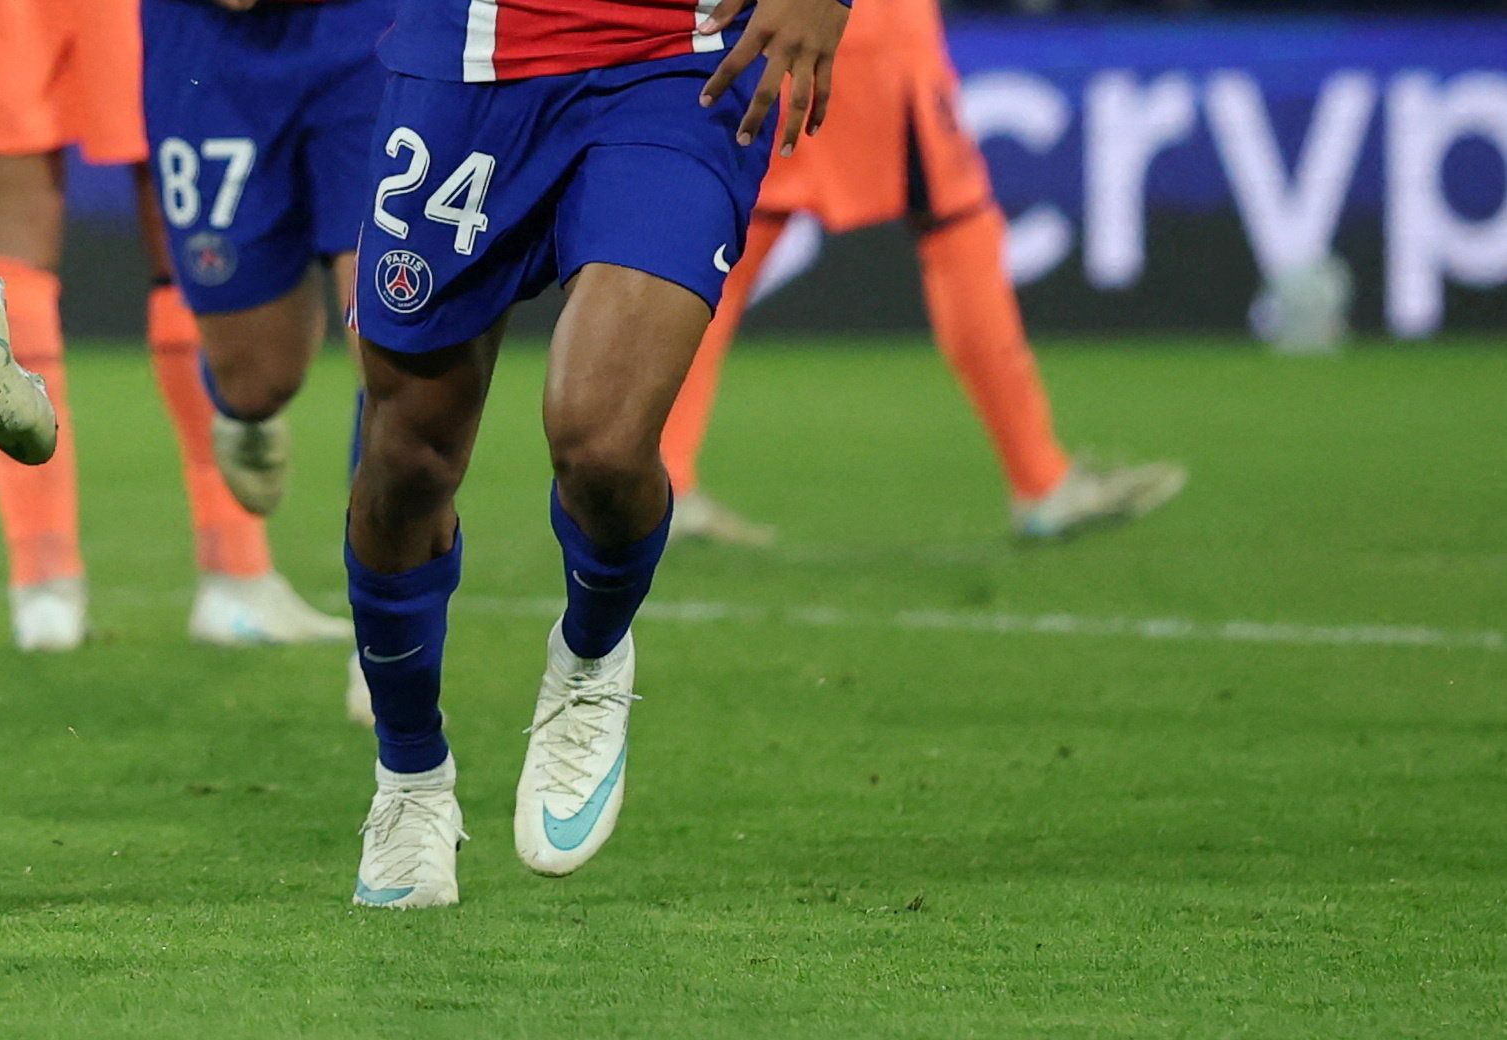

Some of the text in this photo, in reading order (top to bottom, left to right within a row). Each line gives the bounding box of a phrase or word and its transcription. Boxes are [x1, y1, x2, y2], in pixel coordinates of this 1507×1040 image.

[158, 136, 258, 229] 87
[374, 126, 496, 256] 24
[385, 253, 424, 273] PARIS
